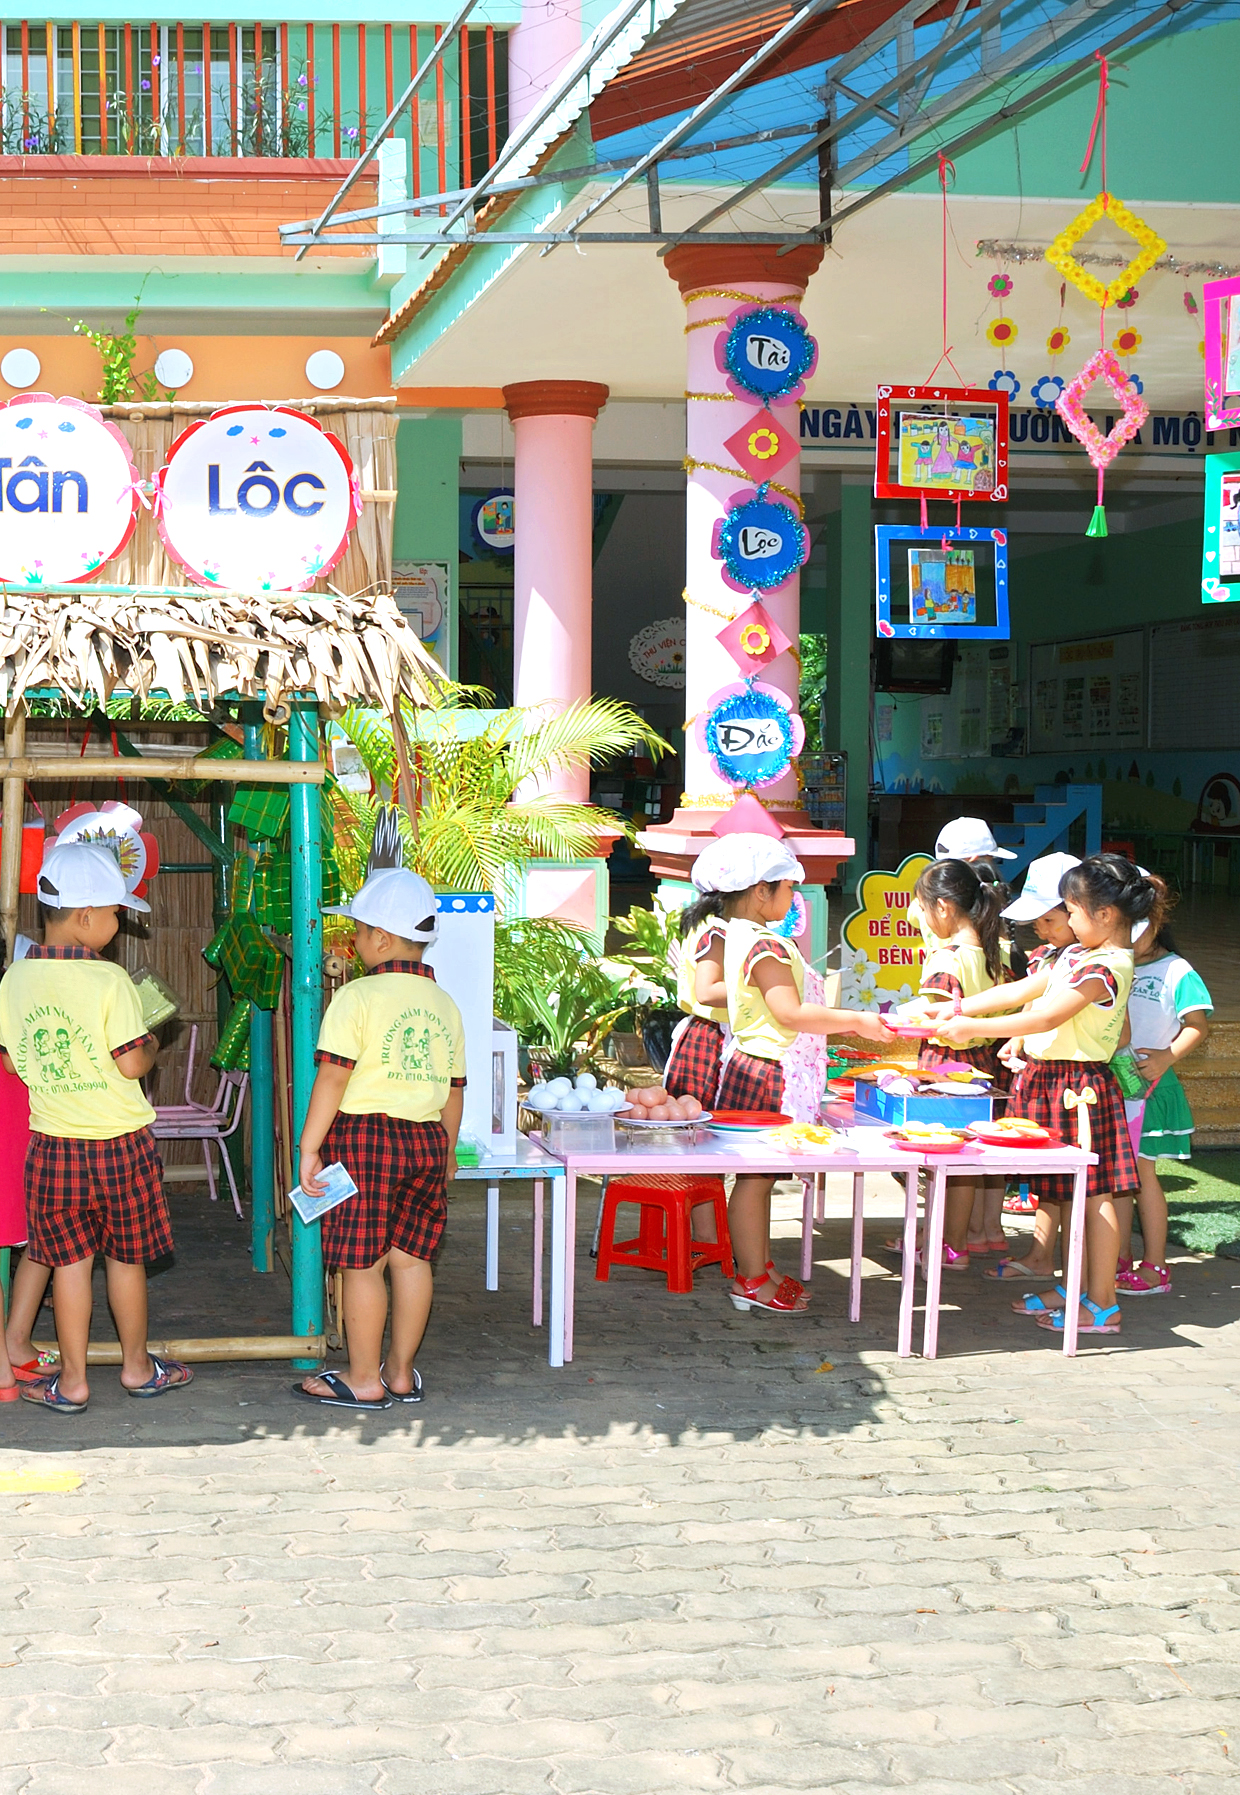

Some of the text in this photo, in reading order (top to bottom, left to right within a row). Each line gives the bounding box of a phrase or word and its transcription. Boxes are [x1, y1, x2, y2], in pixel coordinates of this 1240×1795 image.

[749, 334, 790, 370] Tài
[741, 526, 780, 559] Lộc
[659, 636, 677, 651] VIỆN
[718, 723, 779, 752] Đắc
[884, 892, 910, 909] VUI
[869, 912, 891, 937] ĐỂ
[879, 943, 913, 965] BÊN
[381, 1019, 402, 1066] TRƯỜNG
